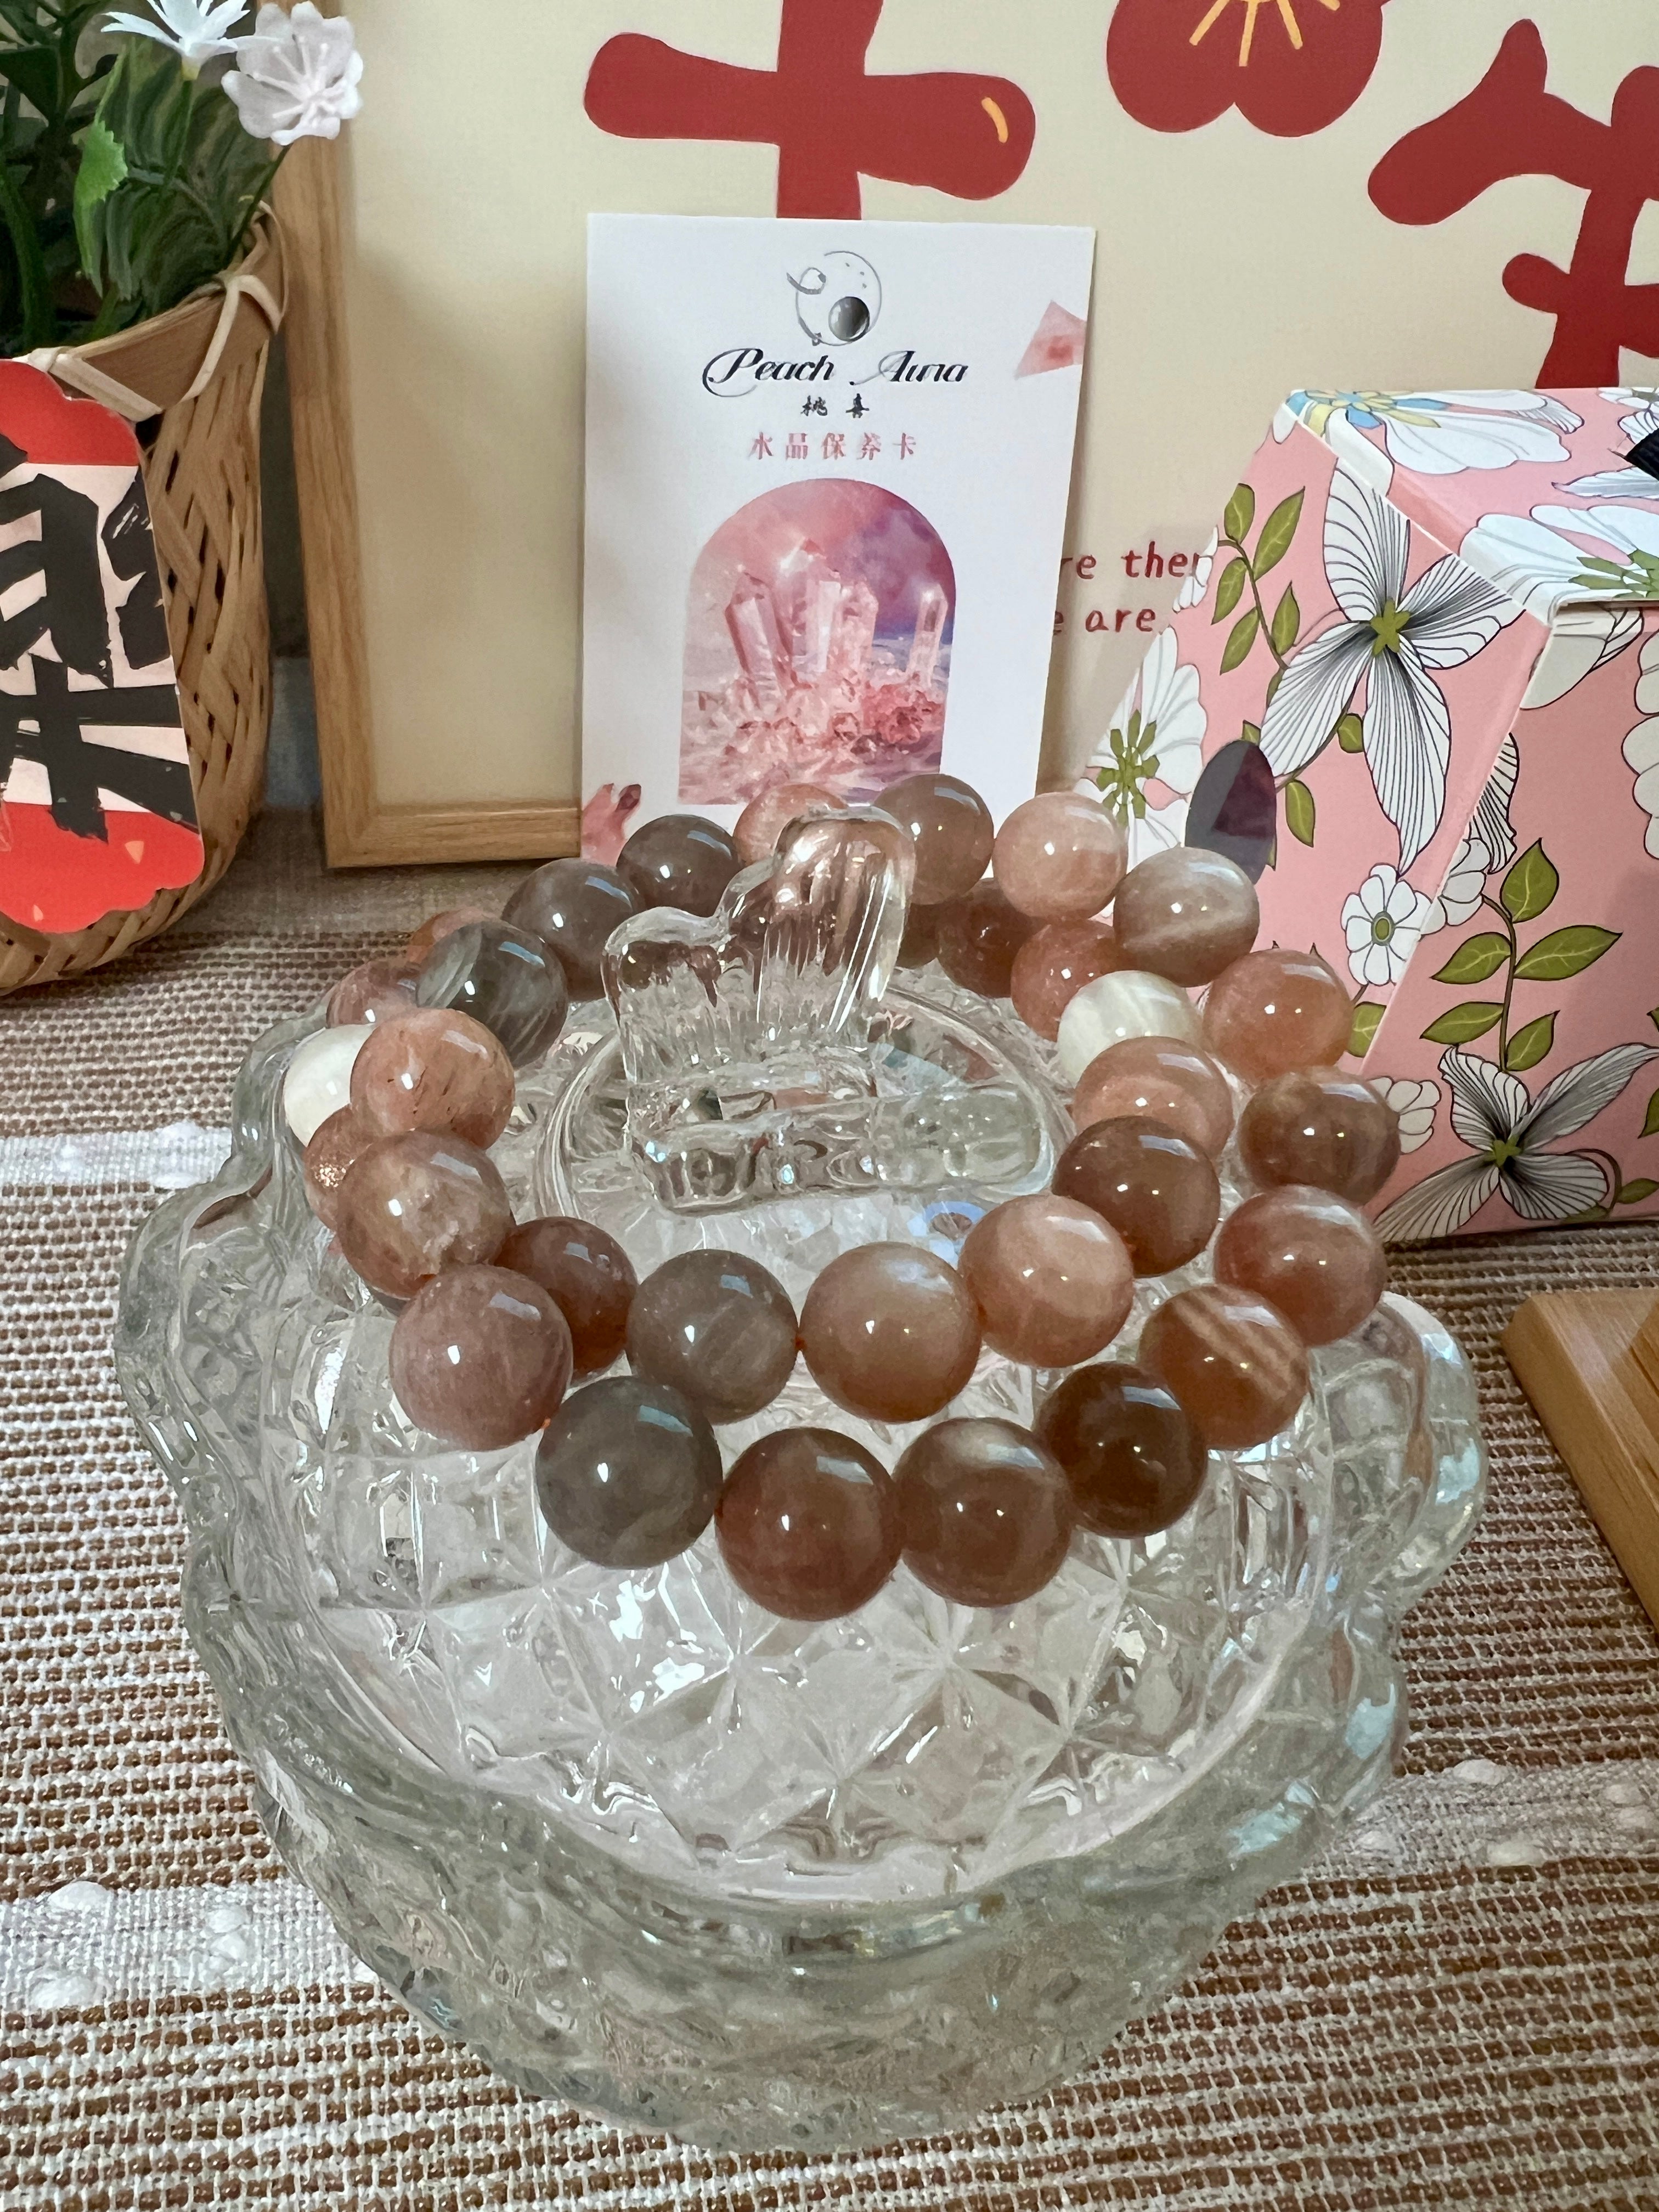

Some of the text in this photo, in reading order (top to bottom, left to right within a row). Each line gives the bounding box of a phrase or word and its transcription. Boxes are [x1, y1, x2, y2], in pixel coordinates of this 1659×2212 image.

[702, 348, 969, 397] Peach Aura
[748, 431, 917, 461] 水晶保养卡
[1085, 608, 1156, 633] are
